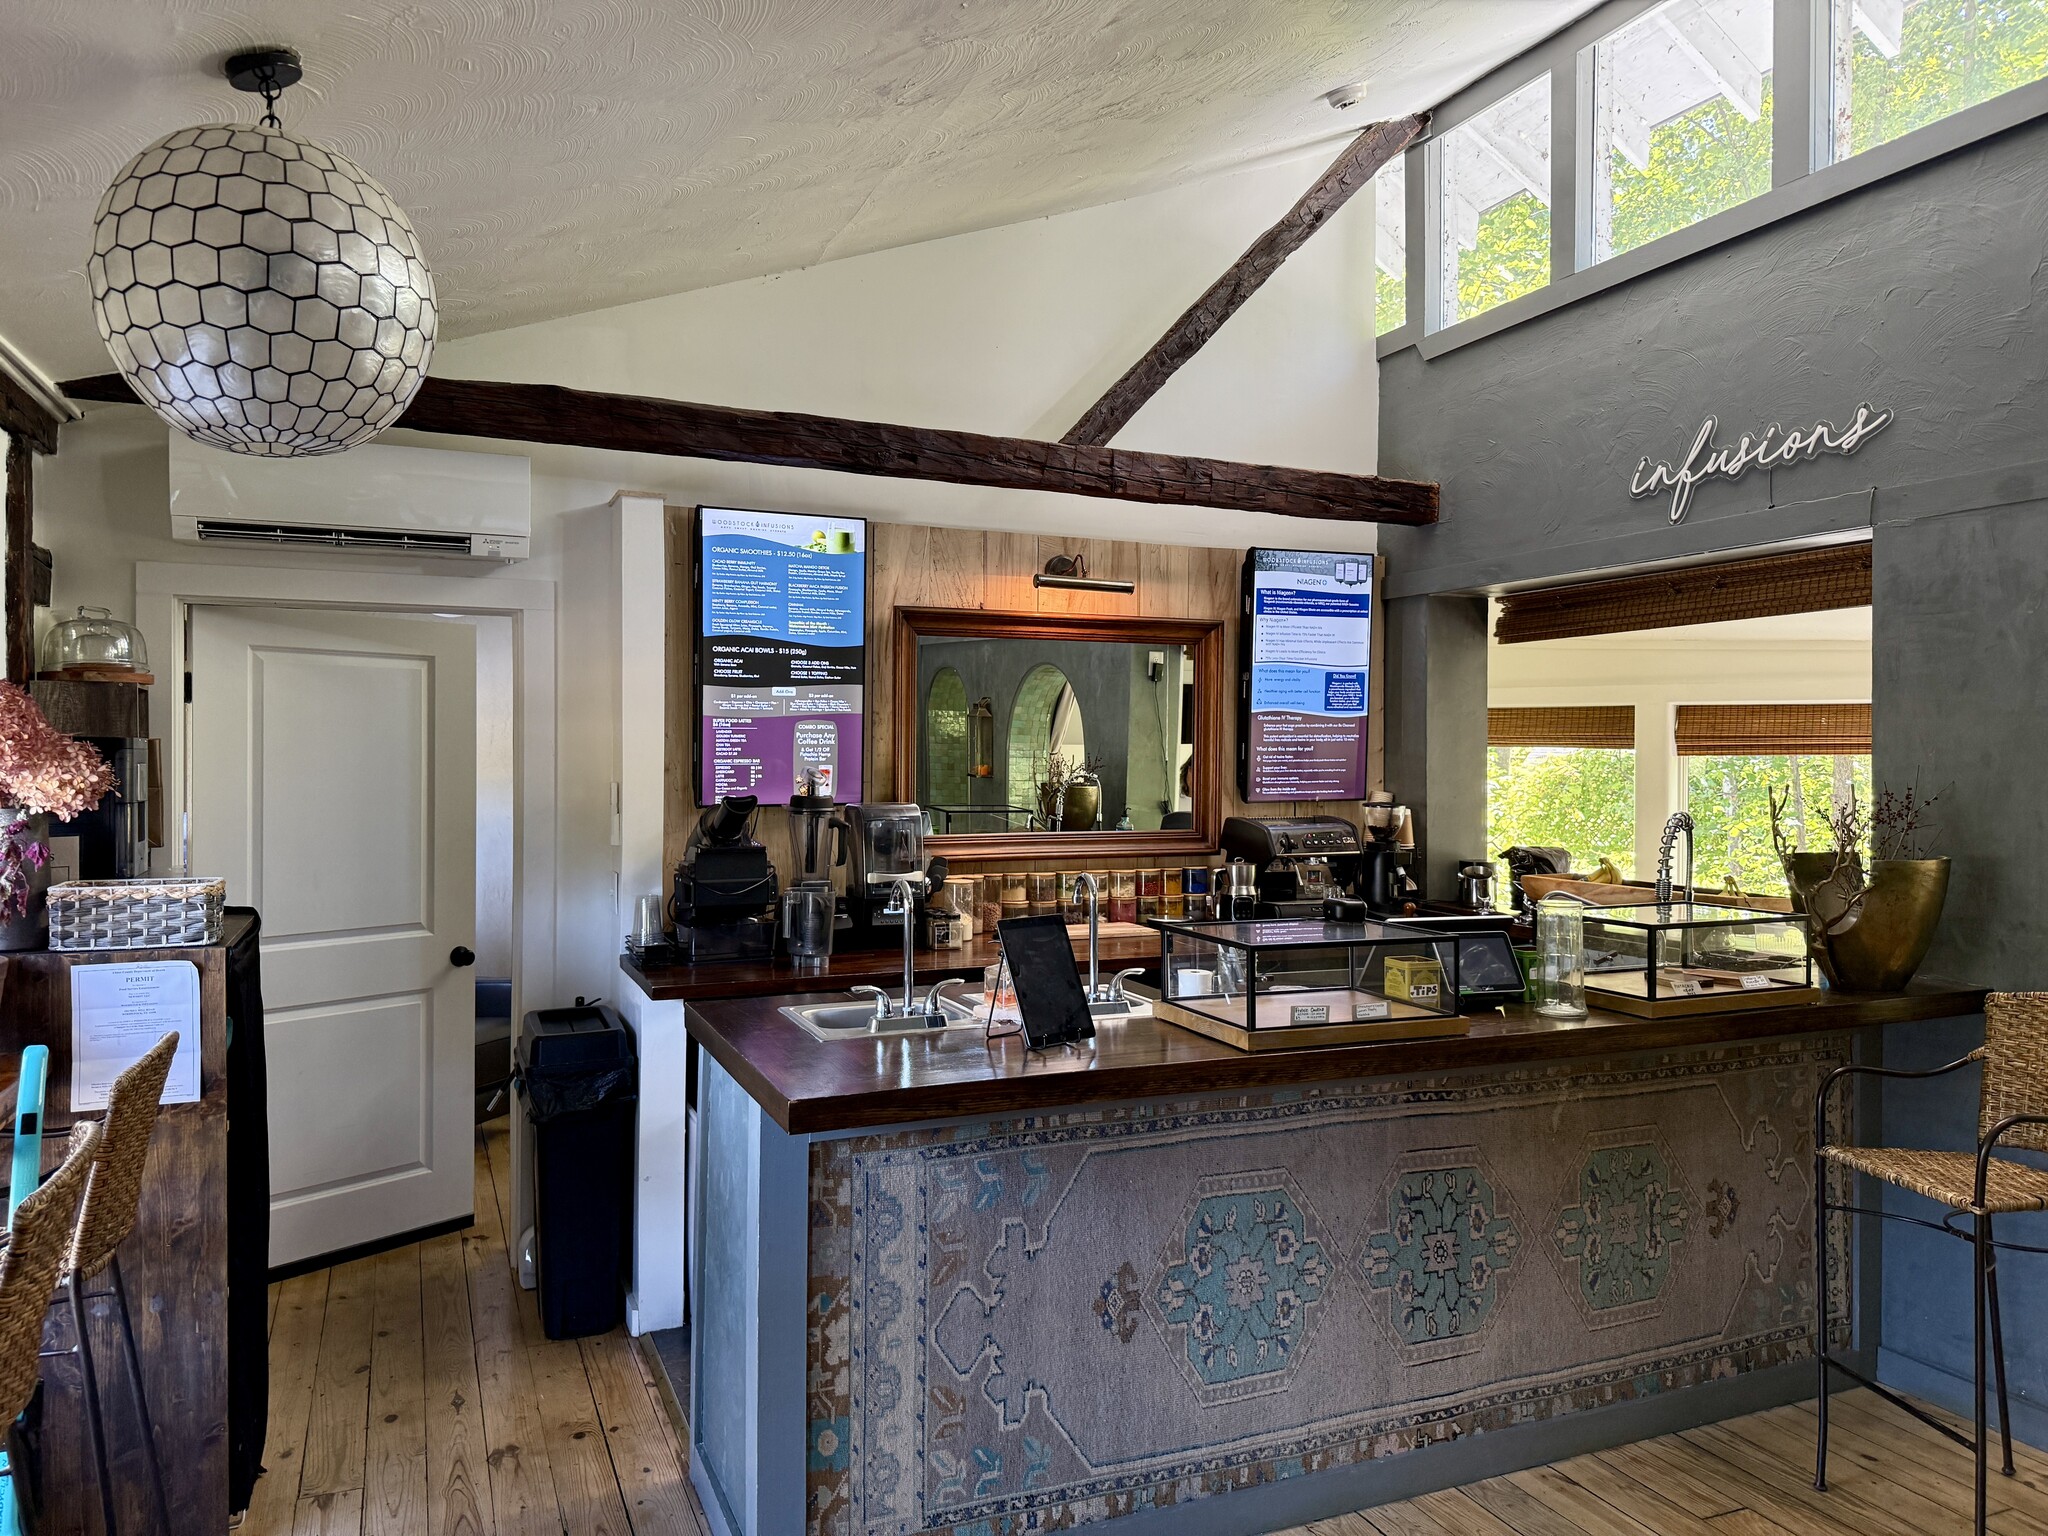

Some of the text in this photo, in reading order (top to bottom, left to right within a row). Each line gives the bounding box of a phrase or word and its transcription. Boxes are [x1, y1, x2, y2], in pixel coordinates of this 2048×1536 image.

[1632, 406, 1888, 521] infusions
[740, 548, 772, 556] SMOOTHIES
[824, 732, 835, 740] Any
